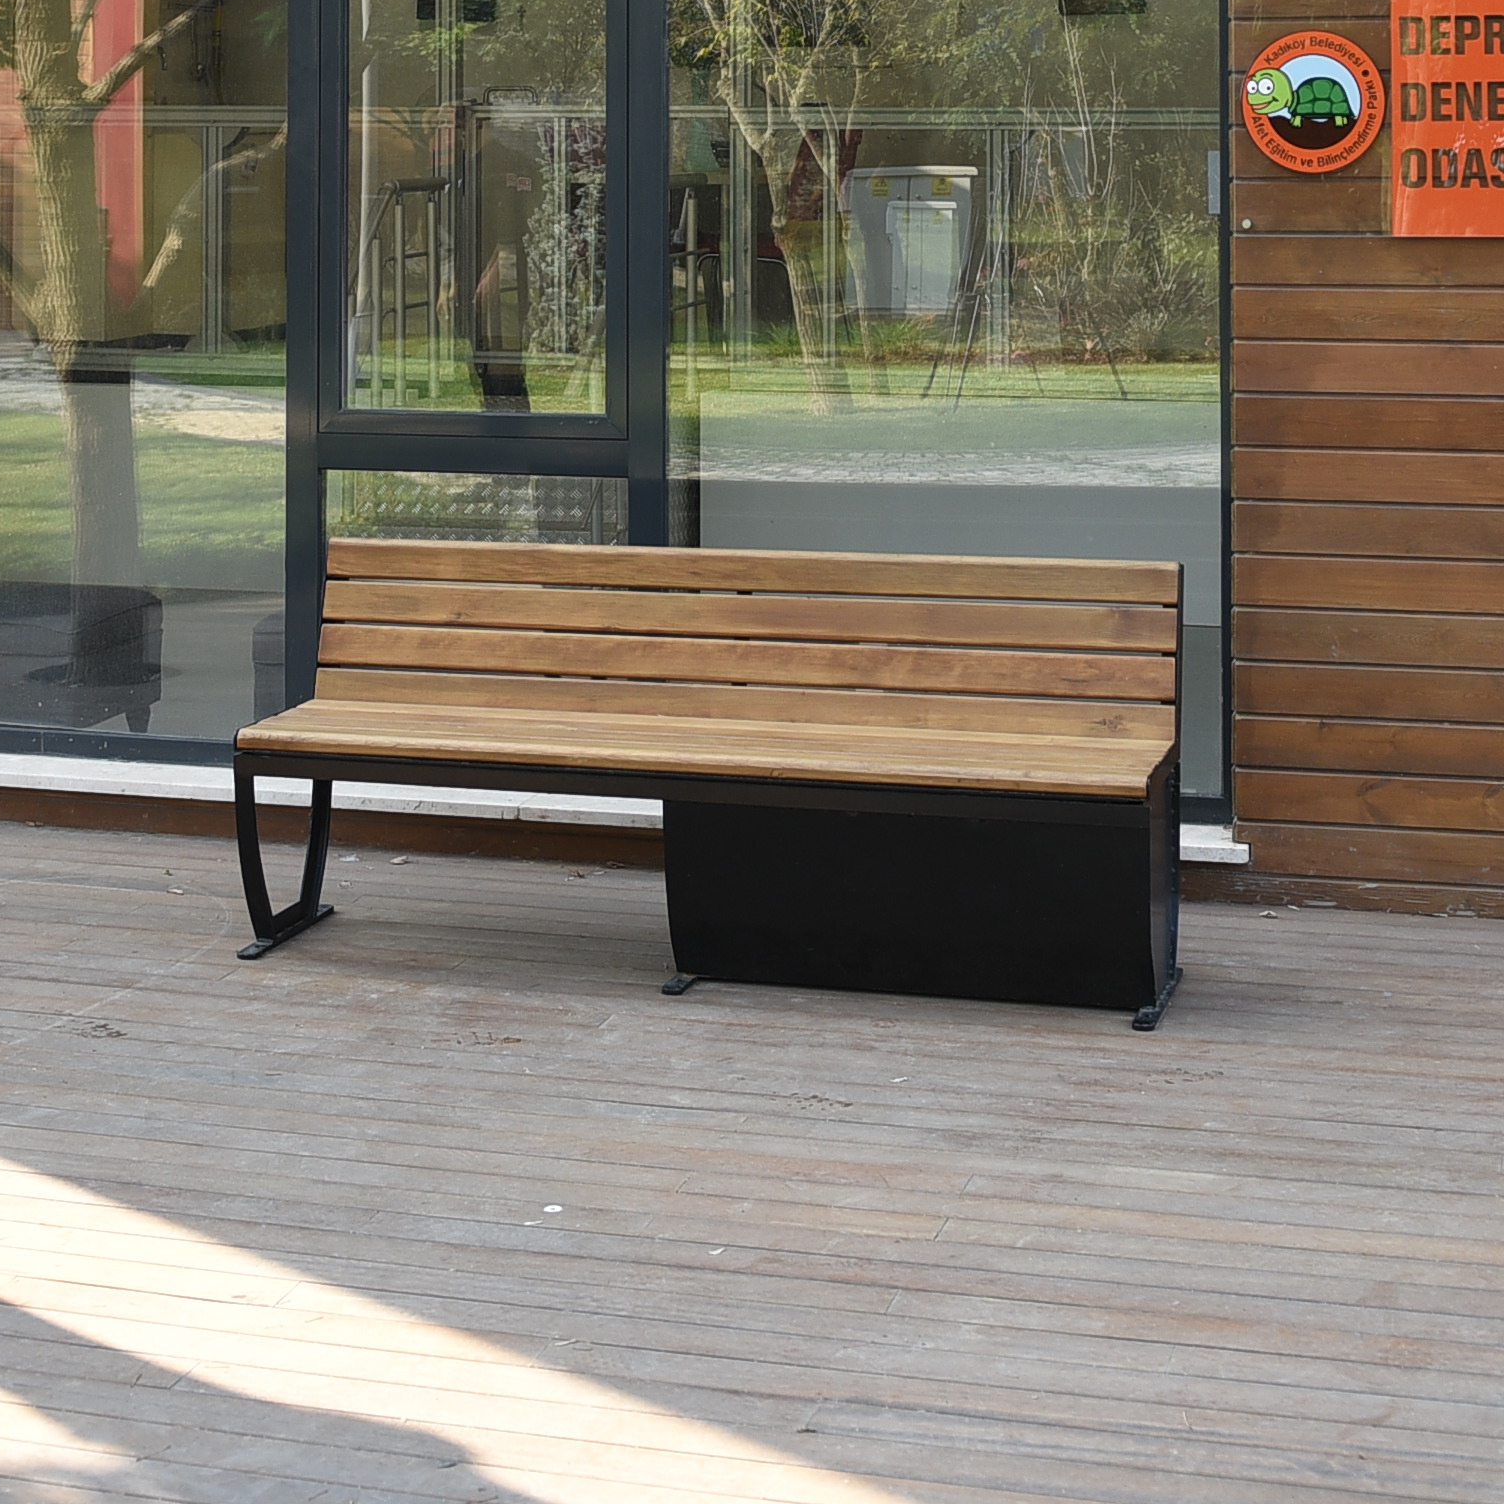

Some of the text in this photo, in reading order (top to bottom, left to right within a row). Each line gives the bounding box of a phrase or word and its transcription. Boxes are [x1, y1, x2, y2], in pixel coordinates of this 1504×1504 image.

[1309, 36, 1365, 68] Belediyesi
[1251, 79, 1379, 168] Afet Eğitim ve Bilinçlendirme Parkı
